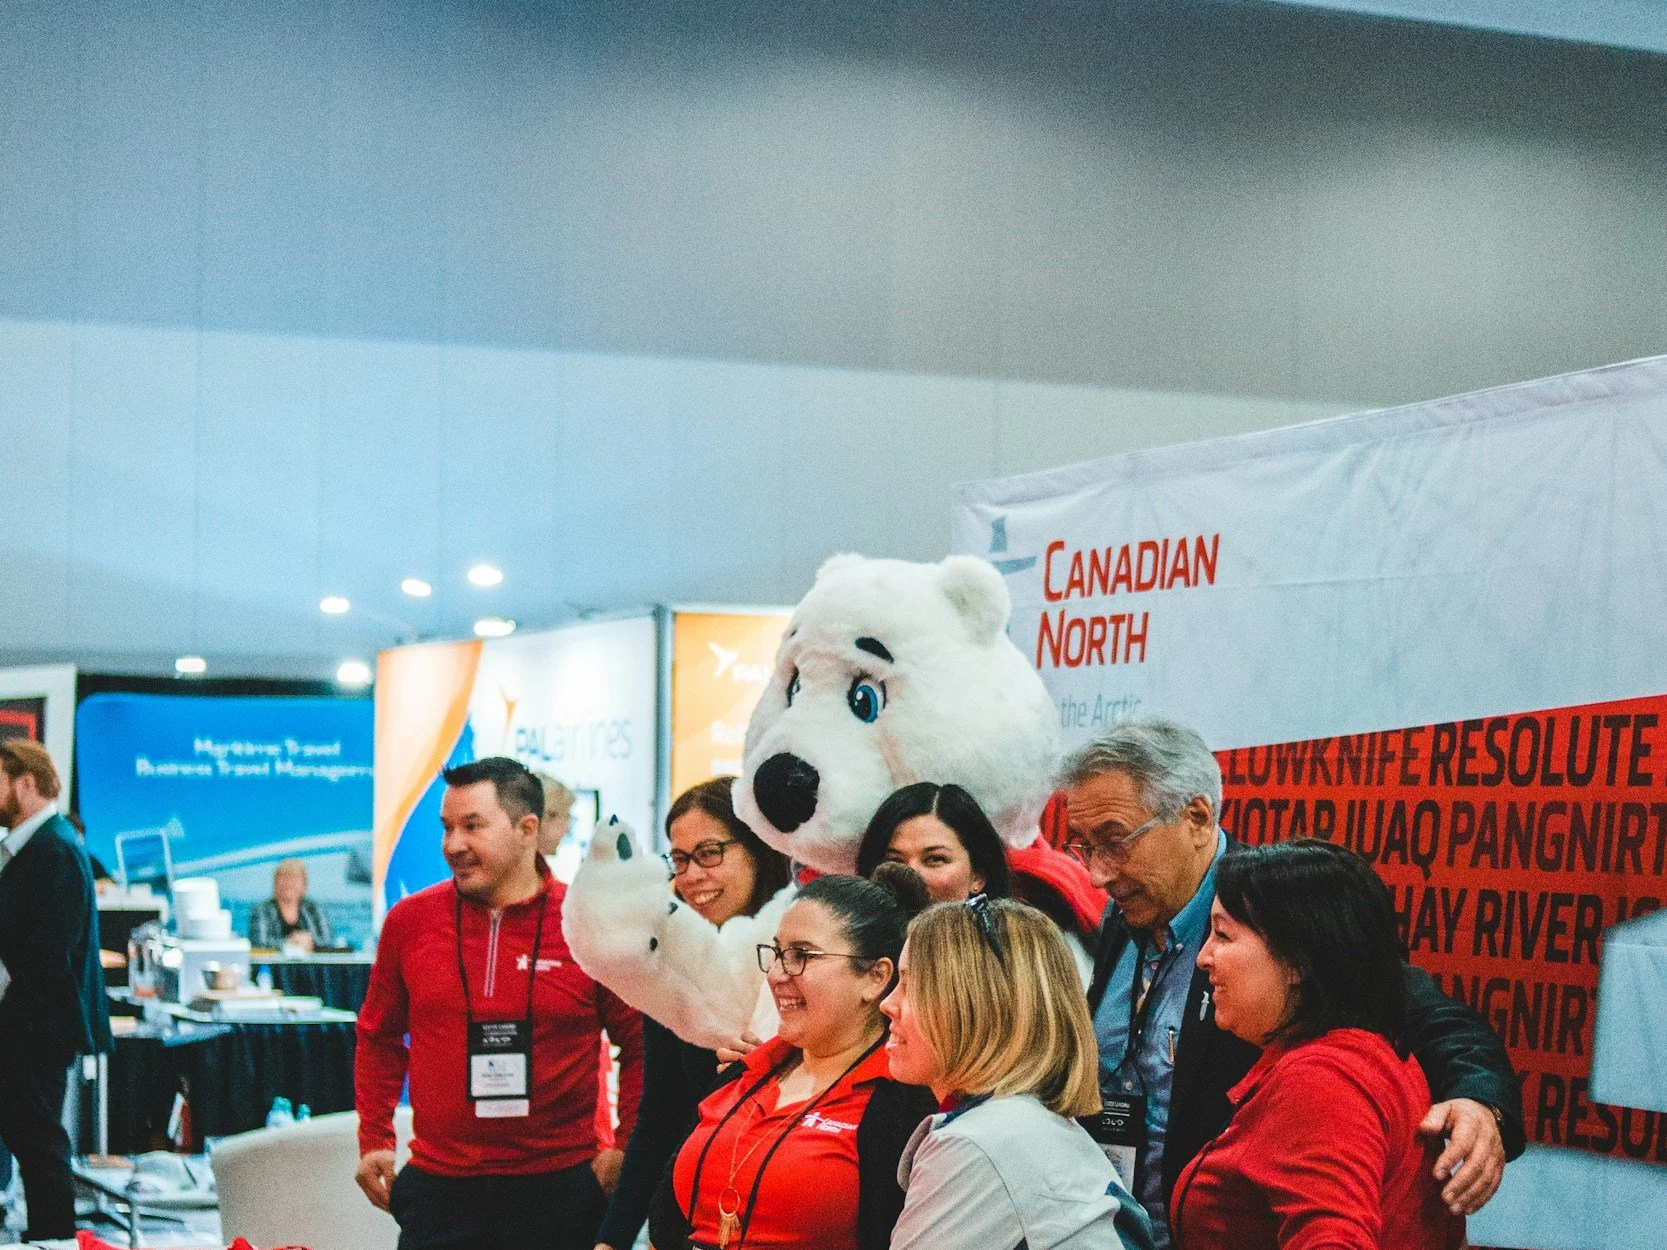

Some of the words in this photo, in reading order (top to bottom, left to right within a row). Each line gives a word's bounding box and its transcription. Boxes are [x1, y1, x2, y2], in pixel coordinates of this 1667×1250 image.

[1044, 533, 1219, 603] CANADIAN
[1036, 608, 1149, 670] NORTH
[1428, 714, 1659, 787] RESOLUTE
[1472, 889, 1603, 965] RIVER
